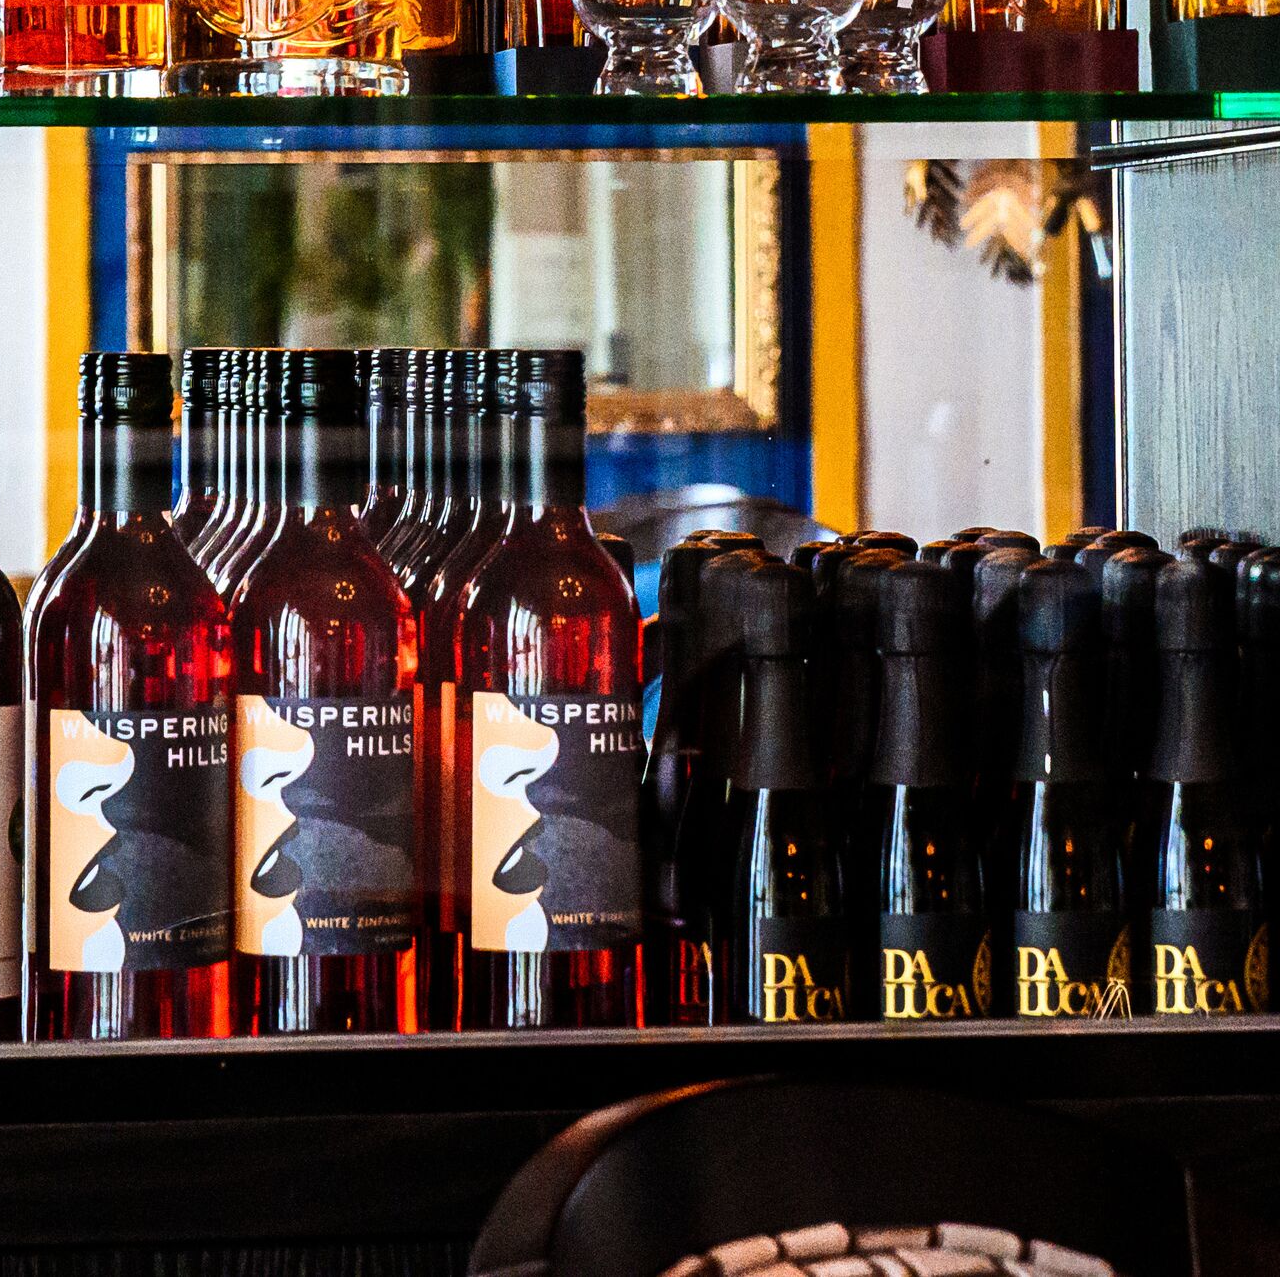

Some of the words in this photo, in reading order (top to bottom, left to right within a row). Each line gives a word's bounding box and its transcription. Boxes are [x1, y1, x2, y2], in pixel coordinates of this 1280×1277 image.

[244, 704, 413, 729] WHISPERING
[484, 702, 639, 725] WHISPERIN
[59, 715, 228, 740] WHISPERING
[167, 742, 228, 768] HILLS
[347, 733, 412, 758] HILLS
[589, 732, 642, 754] HILL
[305, 916, 351, 929] WHITE
[551, 911, 595, 925] WHITE
[128, 929, 172, 943] WHITE
[763, 953, 815, 989] DA
[883, 948, 936, 984] DA
[1017, 946, 1069, 981] DA
[1154, 944, 1207, 979] DA
[763, 986, 845, 1022] LUCA
[883, 982, 972, 1019] LUCA
[1017, 979, 1104, 1016] LUCA
[1154, 977, 1243, 1014] LUCA
